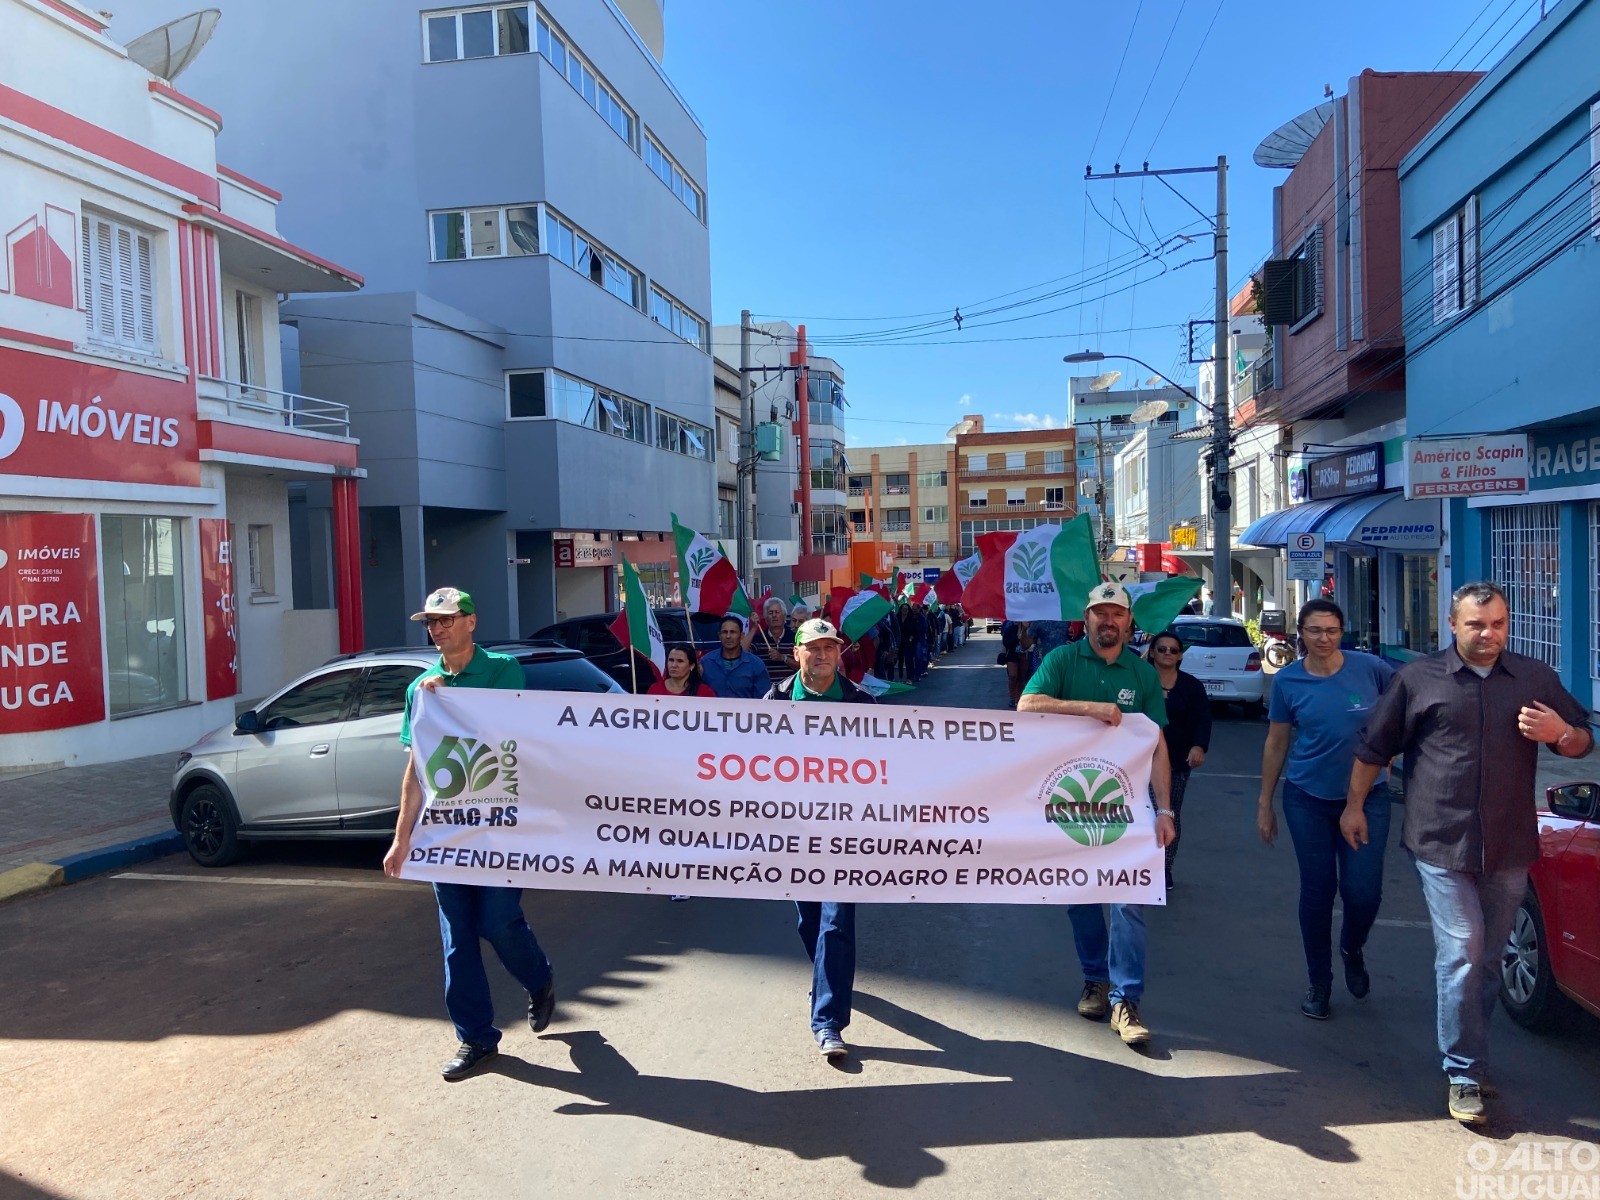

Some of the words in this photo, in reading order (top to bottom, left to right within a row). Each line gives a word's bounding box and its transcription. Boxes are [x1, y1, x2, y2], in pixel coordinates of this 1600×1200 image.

[37, 396, 179, 448] IMÓVEIS
[1413, 448, 1471, 464] Américo
[1476, 444, 1524, 462] Scapin
[1440, 467, 1451, 479] &
[1456, 465, 1497, 478] Filhos
[1415, 480, 1519, 494] FERRAGENS
[1302, 537, 1310, 546] E
[1361, 524, 1435, 535] PEDRINHO
[1411, 534, 1435, 542] PEÇAS
[18, 545, 80, 560] IMÓVEIS
[1, 640, 69, 668] NDE
[1, 680, 74, 710] UGA
[557, 706, 578, 727] A
[588, 705, 795, 735] AGRICULTURA
[804, 713, 935, 740] FAMILIAR
[944, 720, 1016, 743] PEDE
[500, 739, 519, 797] ANOS
[697, 753, 889, 785] SOCORRO!
[1045, 772, 1063, 796] REGIÃO
[1062, 766, 1072, 775] DO
[1073, 762, 1096, 770] MÉDIO
[1097, 764, 1114, 775] ALTO
[465, 797, 519, 805] CONQUISTAS
[584, 794, 722, 818] QUEREMOS
[729, 800, 853, 822] PRODUZIR
[861, 804, 990, 824] ALIMENTOS
[1045, 802, 1135, 824] ASTRMAU
[597, 823, 650, 845] COM
[659, 829, 800, 854] QUALIDADE
[808, 836, 822, 854] E
[829, 837, 982, 859] SEGURANÇA!
[409, 847, 575, 874] DEFENDEMOS
[583, 857, 600, 876] A
[608, 858, 783, 885] MANUTENÇÃO
[790, 867, 826, 885] DO
[833, 868, 948, 887] PROAGRO
[955, 868, 969, 885] E
[976, 868, 1089, 887] PROAGRO
[1097, 868, 1152, 887] MAIS
